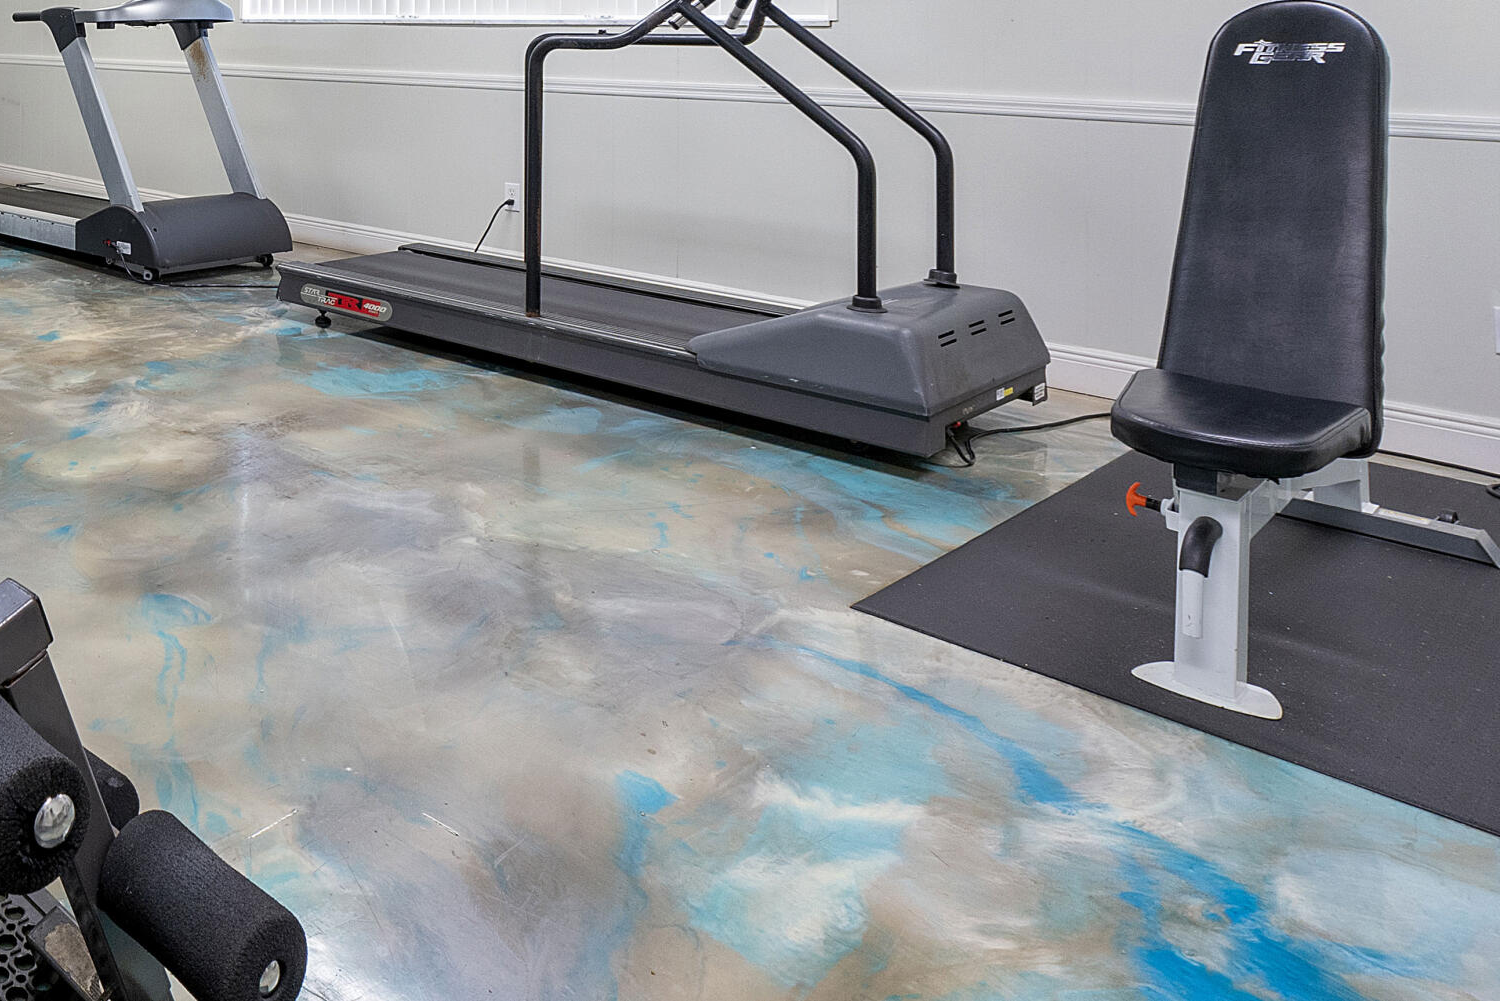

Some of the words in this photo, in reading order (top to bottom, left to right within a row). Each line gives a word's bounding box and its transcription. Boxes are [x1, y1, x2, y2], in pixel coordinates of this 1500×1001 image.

[1233, 42, 1346, 56] FITNESS
[1249, 52, 1326, 64] GEAR
[304, 286, 320, 295] STAR
[318, 296, 336, 305] TRAC
[363, 302, 387, 313] 4000
